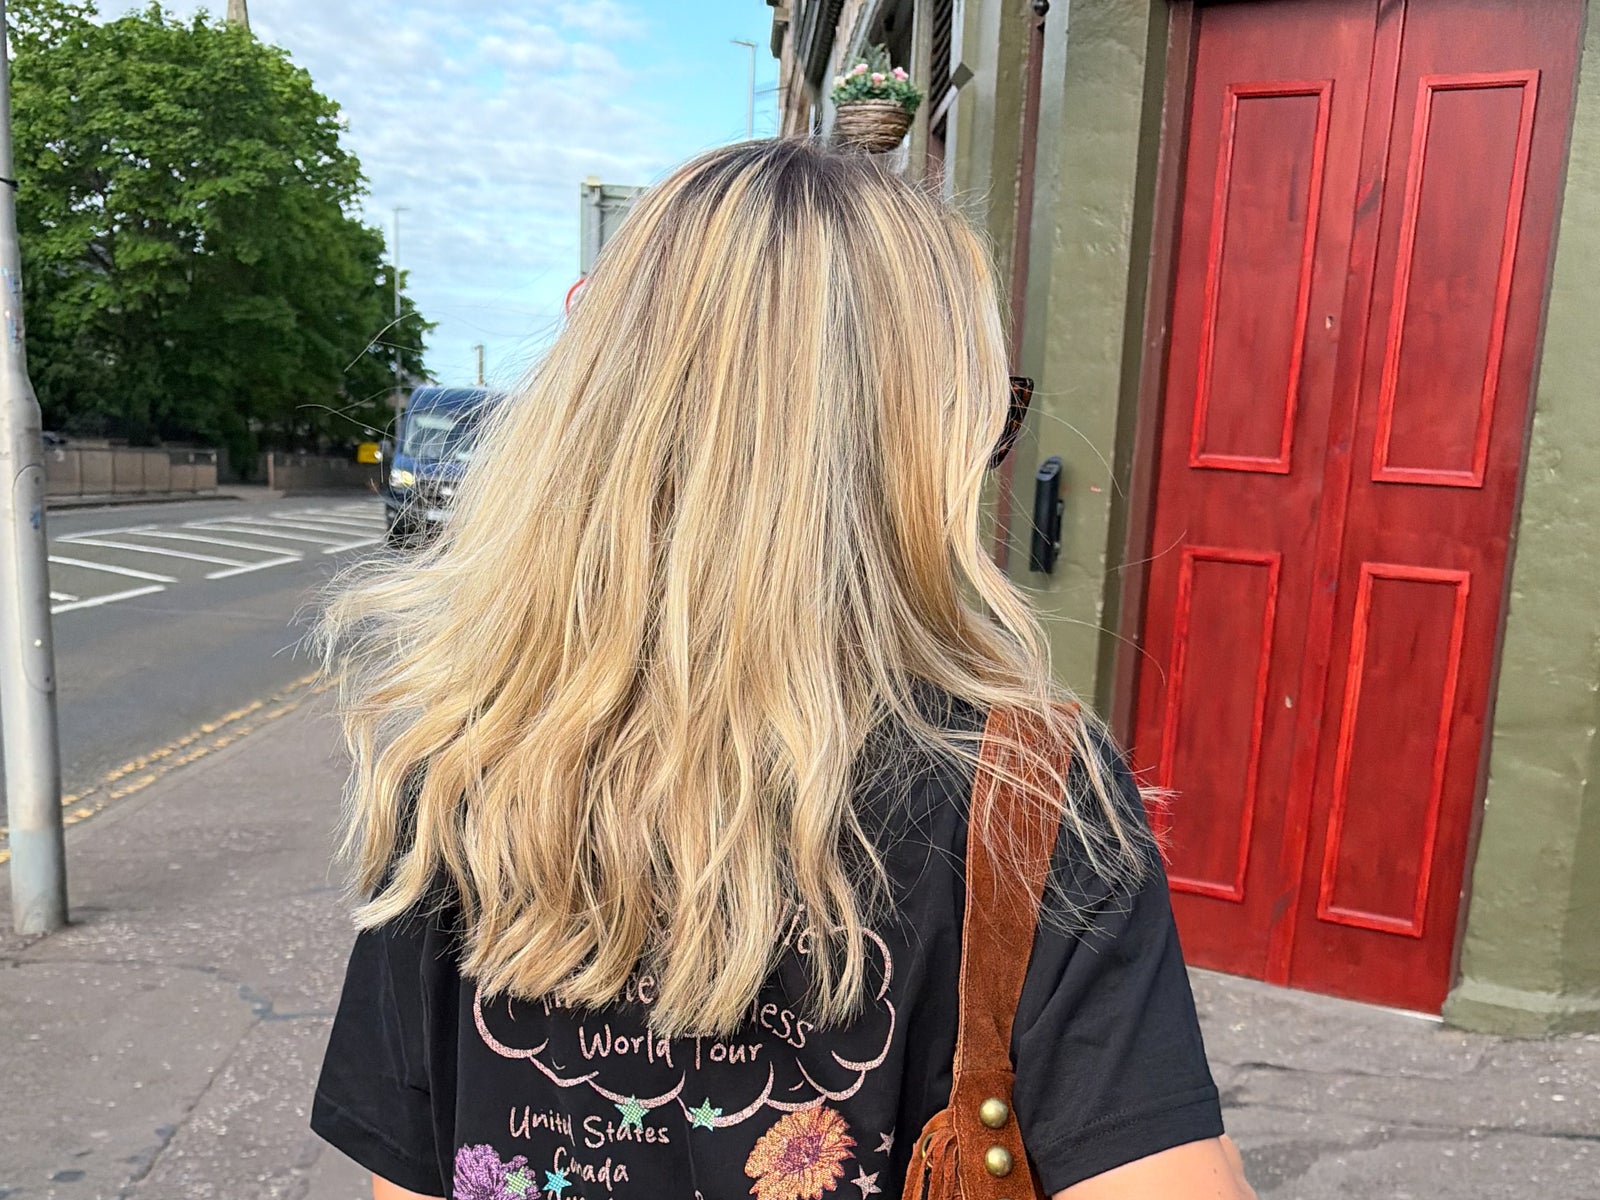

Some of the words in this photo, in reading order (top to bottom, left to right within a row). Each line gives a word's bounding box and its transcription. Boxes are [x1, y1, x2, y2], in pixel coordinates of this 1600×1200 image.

[578, 1023, 675, 1069] World
[684, 1031, 764, 1070] Tour
[582, 1115, 671, 1149] States
